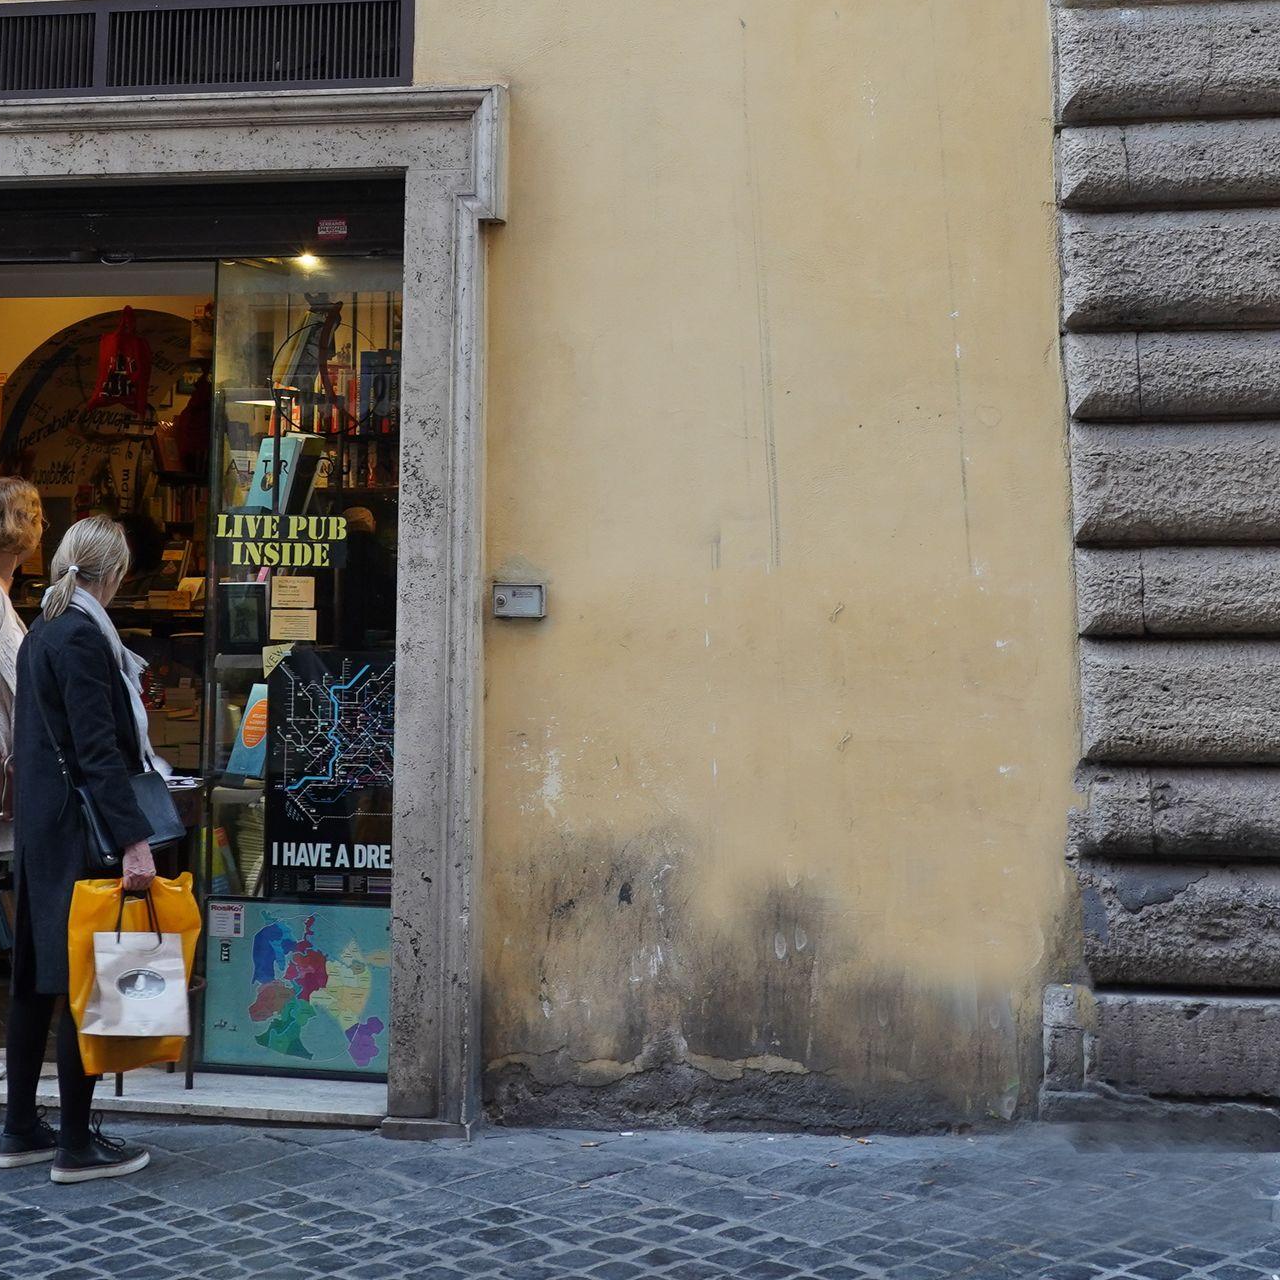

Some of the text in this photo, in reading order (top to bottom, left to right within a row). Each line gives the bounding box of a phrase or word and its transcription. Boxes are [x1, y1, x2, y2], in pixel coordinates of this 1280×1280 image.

[216, 514, 347, 540] LIVE PUB
[231, 541, 330, 567] INSIDE
[272, 841, 278, 866] I
[282, 842, 332, 868] HAVE
[334, 843, 350, 869] A
